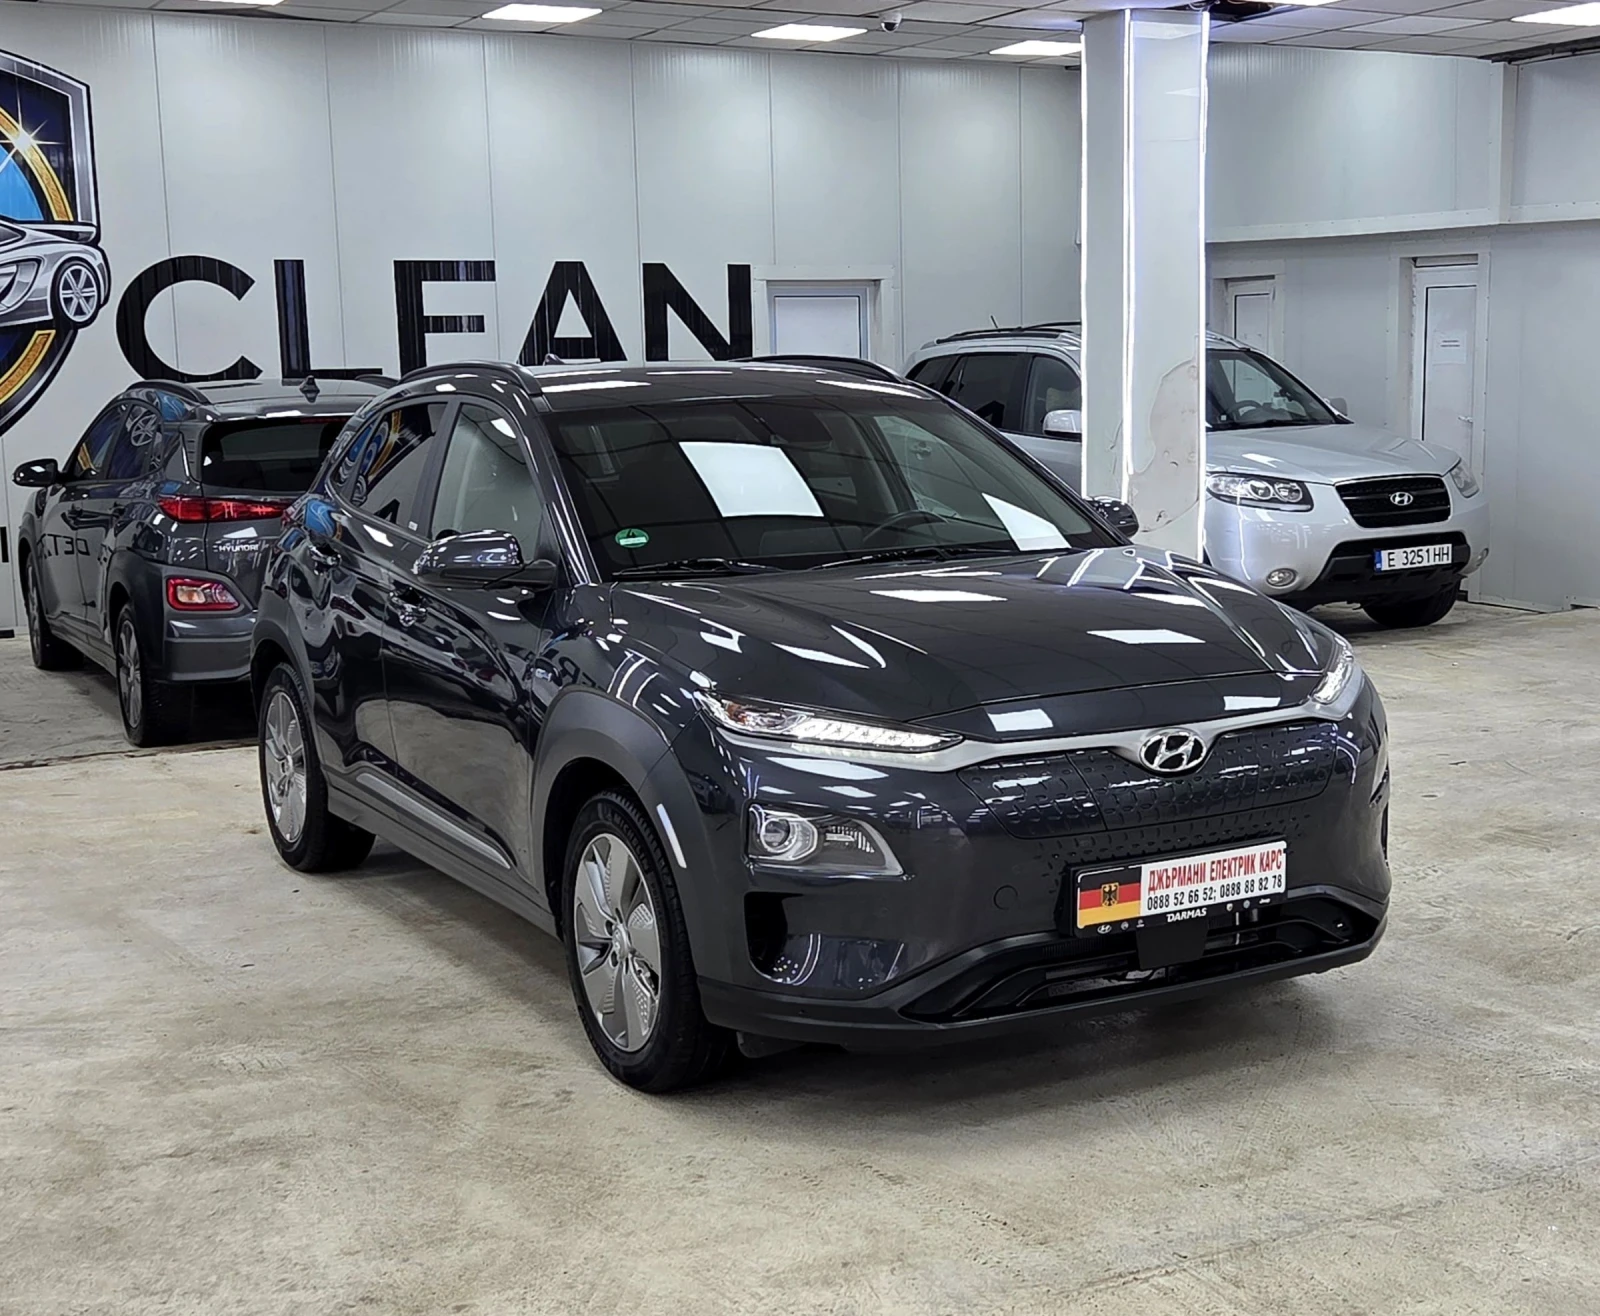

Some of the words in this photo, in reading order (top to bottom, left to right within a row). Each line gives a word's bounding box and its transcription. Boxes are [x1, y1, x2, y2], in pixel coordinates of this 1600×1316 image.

[219, 544, 259, 552] HYUNDAI
[1402, 549, 1430, 565] 3251
[1148, 862, 1206, 895] ДЖЪРМАНИ
[1210, 854, 1256, 881] ЕЛЕКТРИК
[1260, 849, 1282, 872] КАРС
[1147, 894, 1170, 911] 0888
[1173, 892, 1185, 907] 52
[1188, 889, 1199, 903] 66
[1202, 886, 1217, 902] 52;
[1220, 881, 1241, 899] 0888
[1244, 879, 1255, 894] 88
[1258, 876, 1269, 891] 82
[1272, 874, 1283, 889] 78
[1166, 907, 1207, 923] DARMAS
